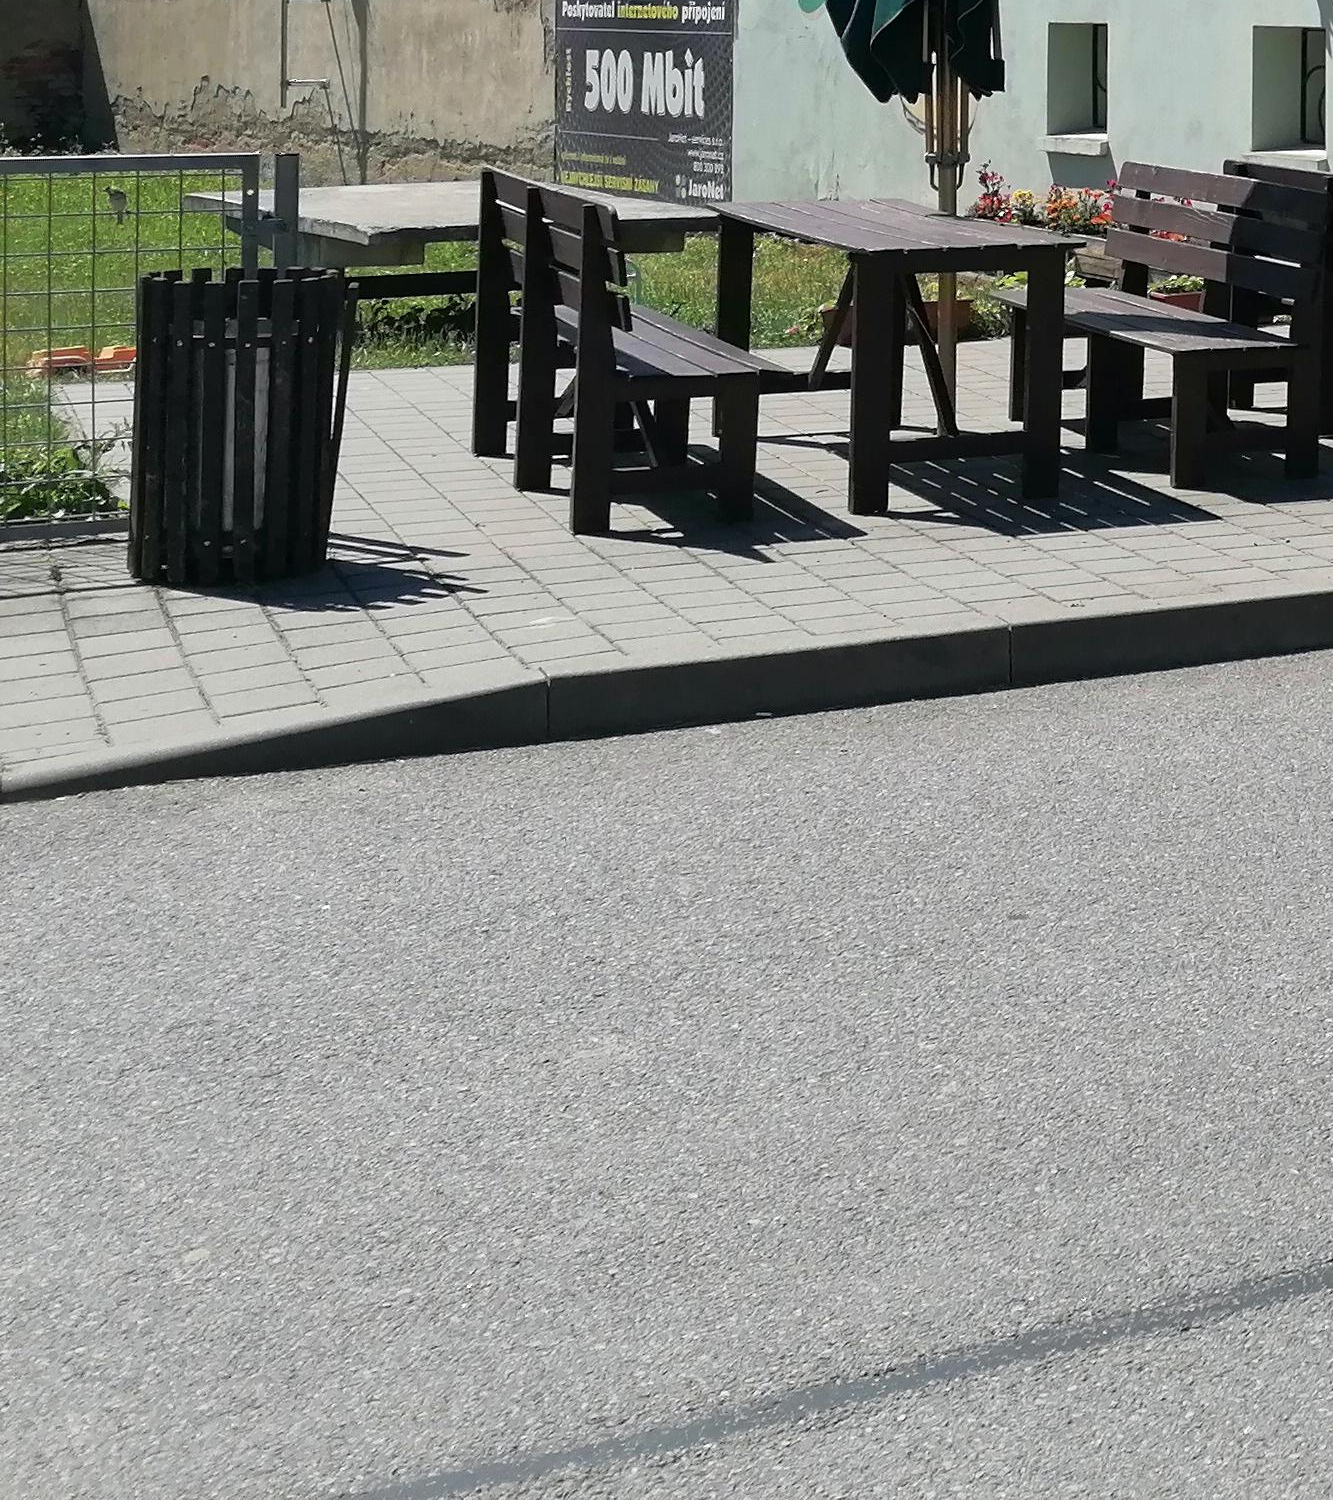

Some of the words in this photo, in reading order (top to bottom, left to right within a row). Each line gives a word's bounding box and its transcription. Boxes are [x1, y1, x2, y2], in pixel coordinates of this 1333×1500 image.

[561, 0, 615, 22] Poskytovatel
[617, 0, 679, 20] internetového
[681, 1, 726, 24] připojení
[584, 49, 634, 114] 500
[640, 48, 705, 120] Mbit
[688, 178, 725, 200] JaroNet
